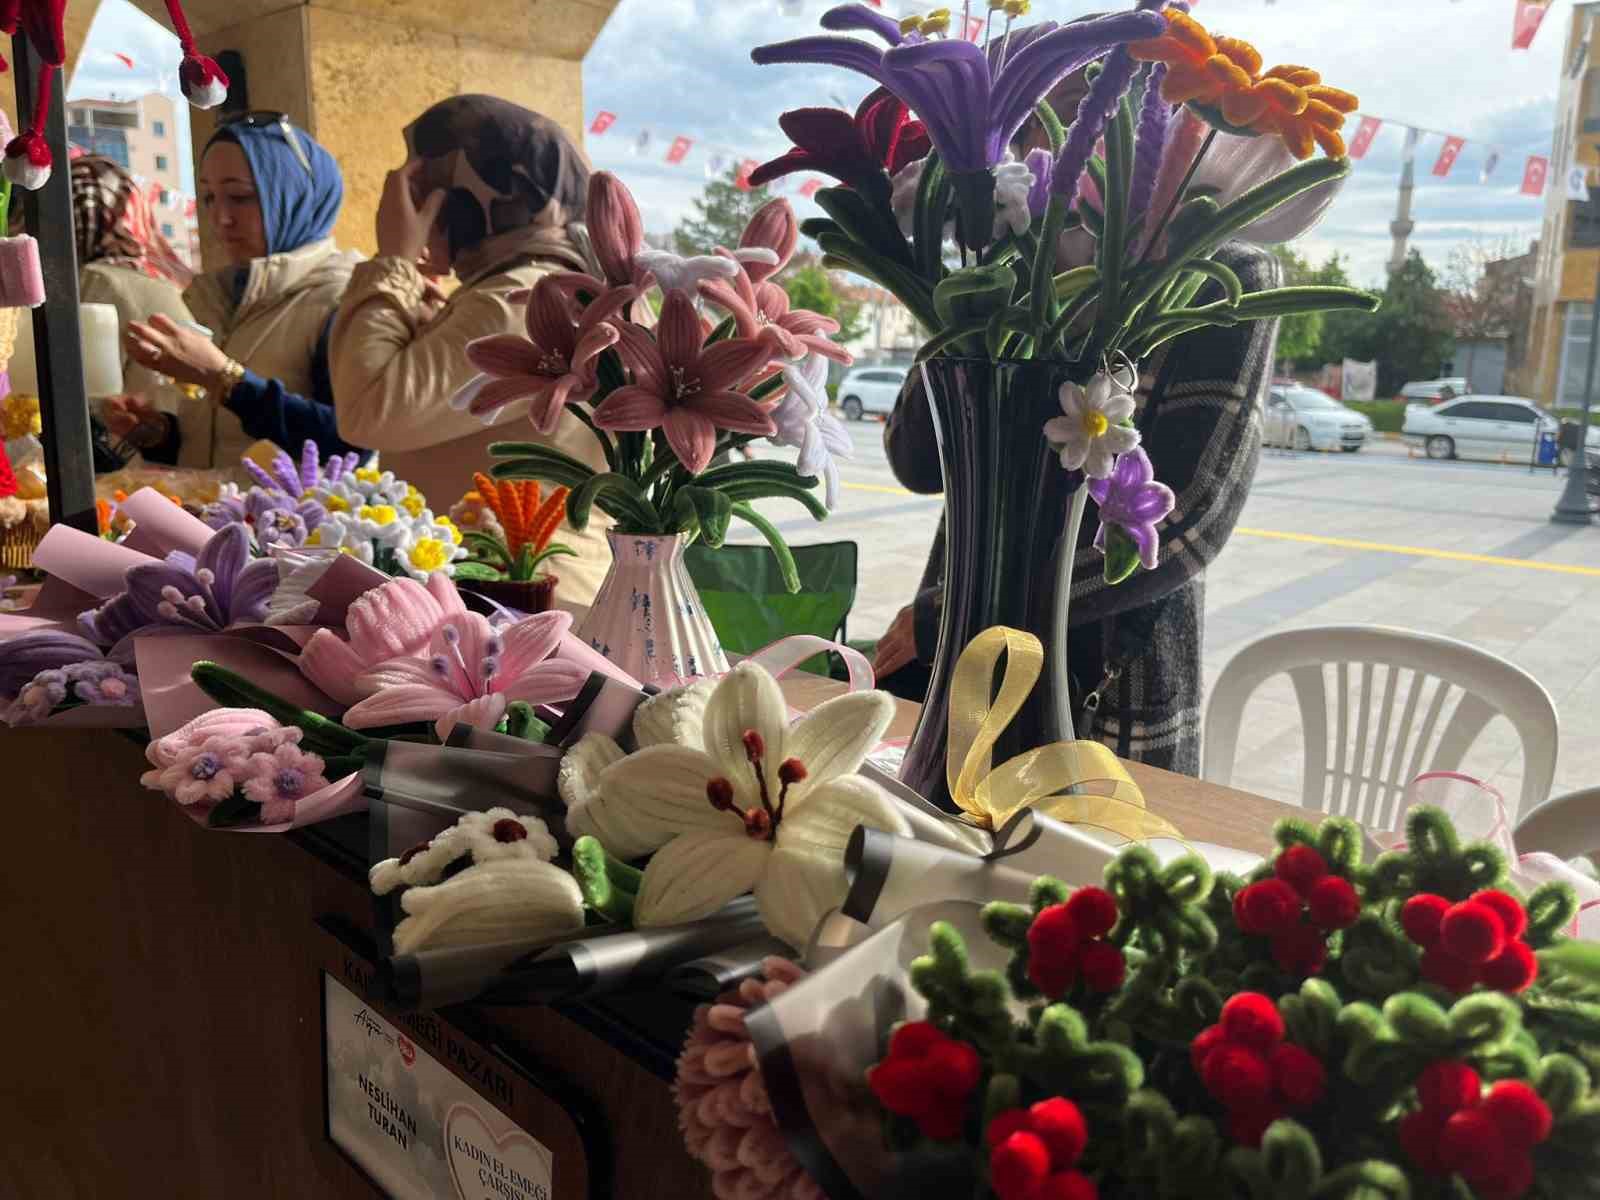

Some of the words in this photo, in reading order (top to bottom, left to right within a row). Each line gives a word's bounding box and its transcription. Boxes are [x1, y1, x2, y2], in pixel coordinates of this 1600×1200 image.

[448, 1041, 513, 1106] PAZARI
[358, 1074, 417, 1137] NESLİHAN
[367, 1102, 407, 1150] TURAN
[454, 1135, 491, 1169] KADIN
[493, 1158, 508, 1179] EL
